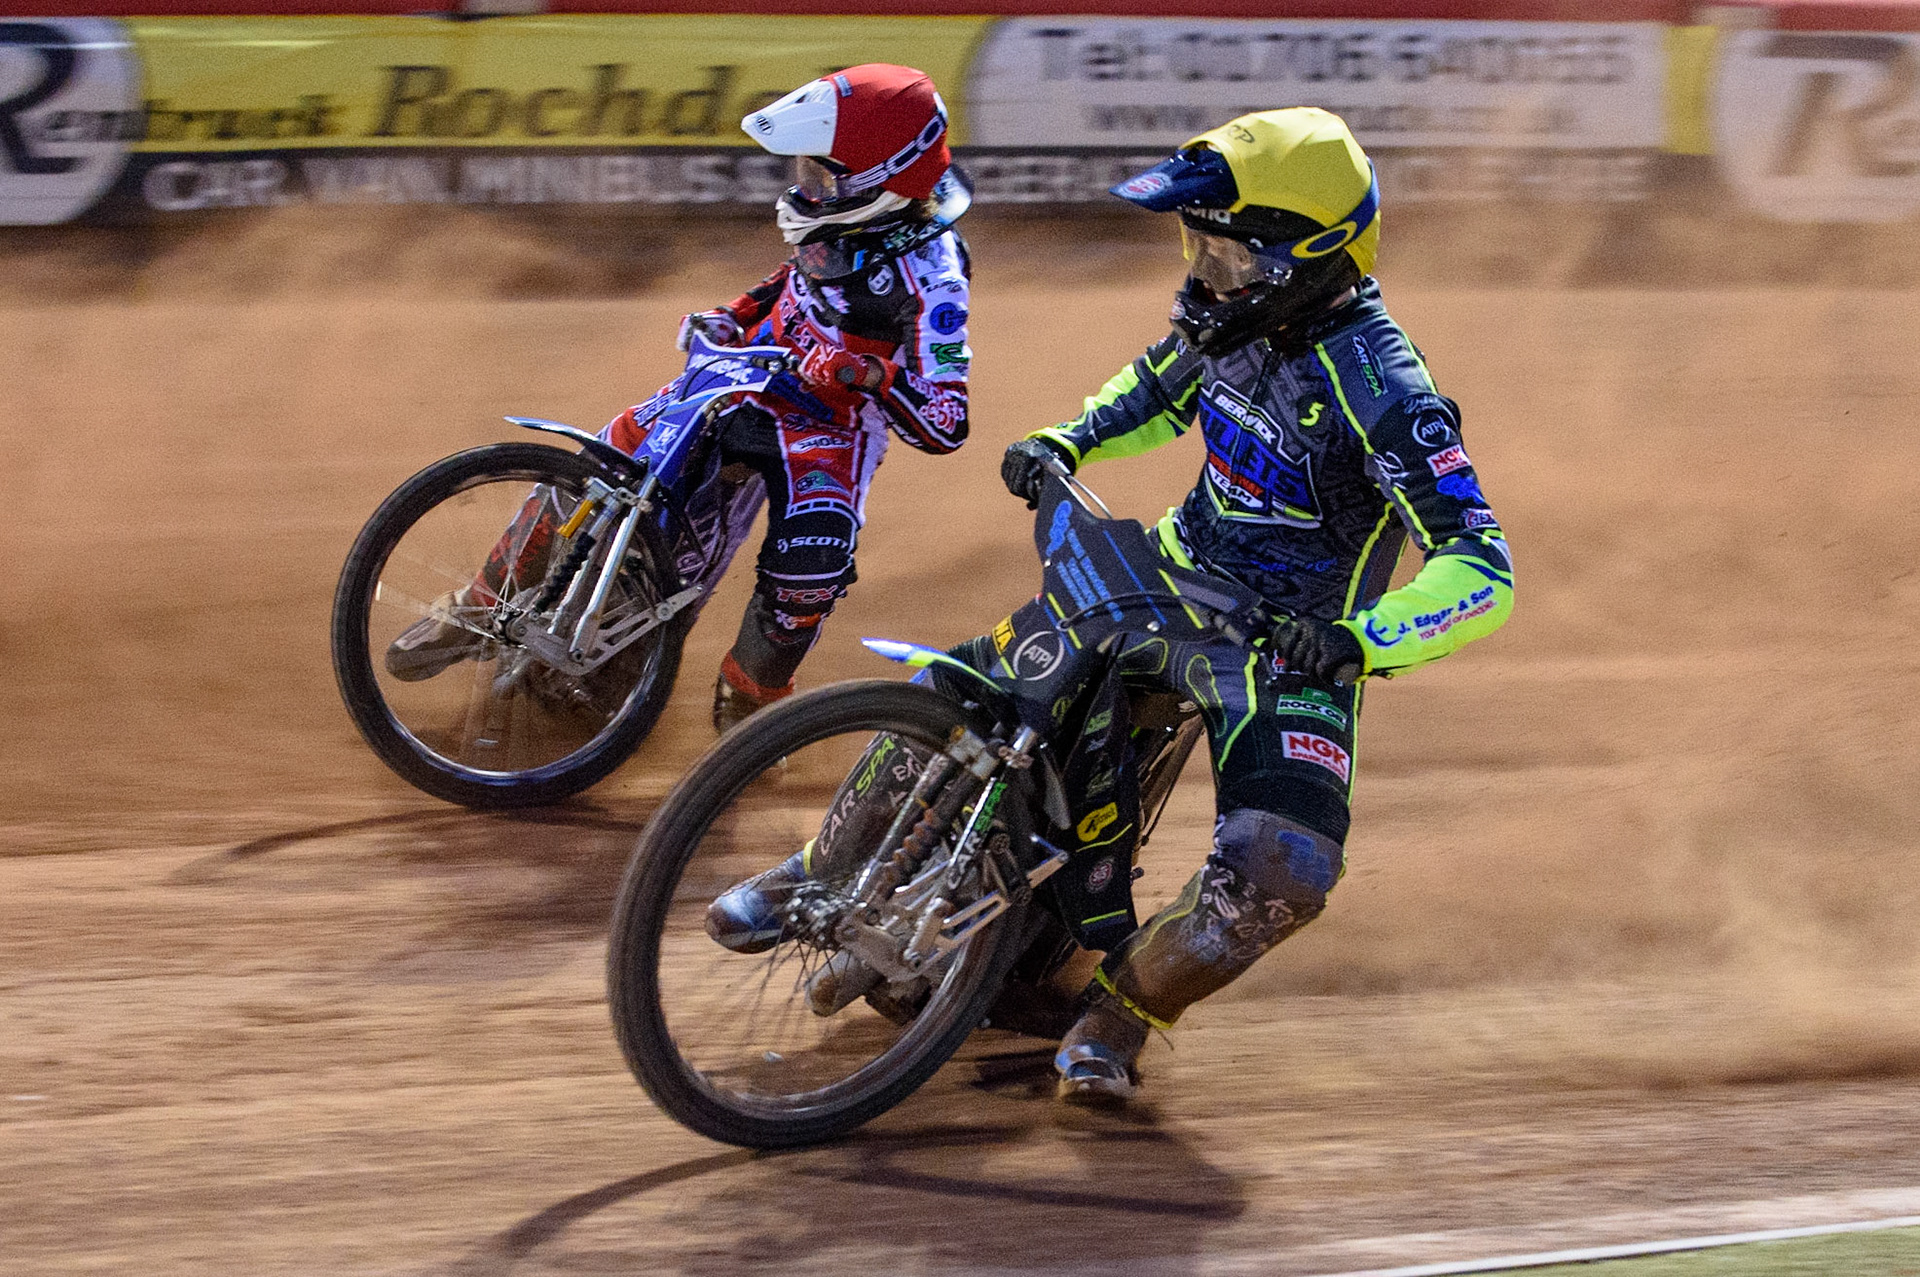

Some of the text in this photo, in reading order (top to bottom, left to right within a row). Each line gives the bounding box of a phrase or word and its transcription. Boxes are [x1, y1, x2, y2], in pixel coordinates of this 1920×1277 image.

[363, 64, 800, 137] Rochd
[1214, 393, 1277, 445] BERWICK
[1214, 472, 1253, 503] TEAM
[1413, 607, 1454, 628] Edgar
[1458, 599, 1469, 612] &
[1470, 586, 1494, 605] Son
[1022, 644, 1055, 669] ATPI
[1280, 700, 1322, 713] ROCK
[1288, 734, 1346, 769] NGK
